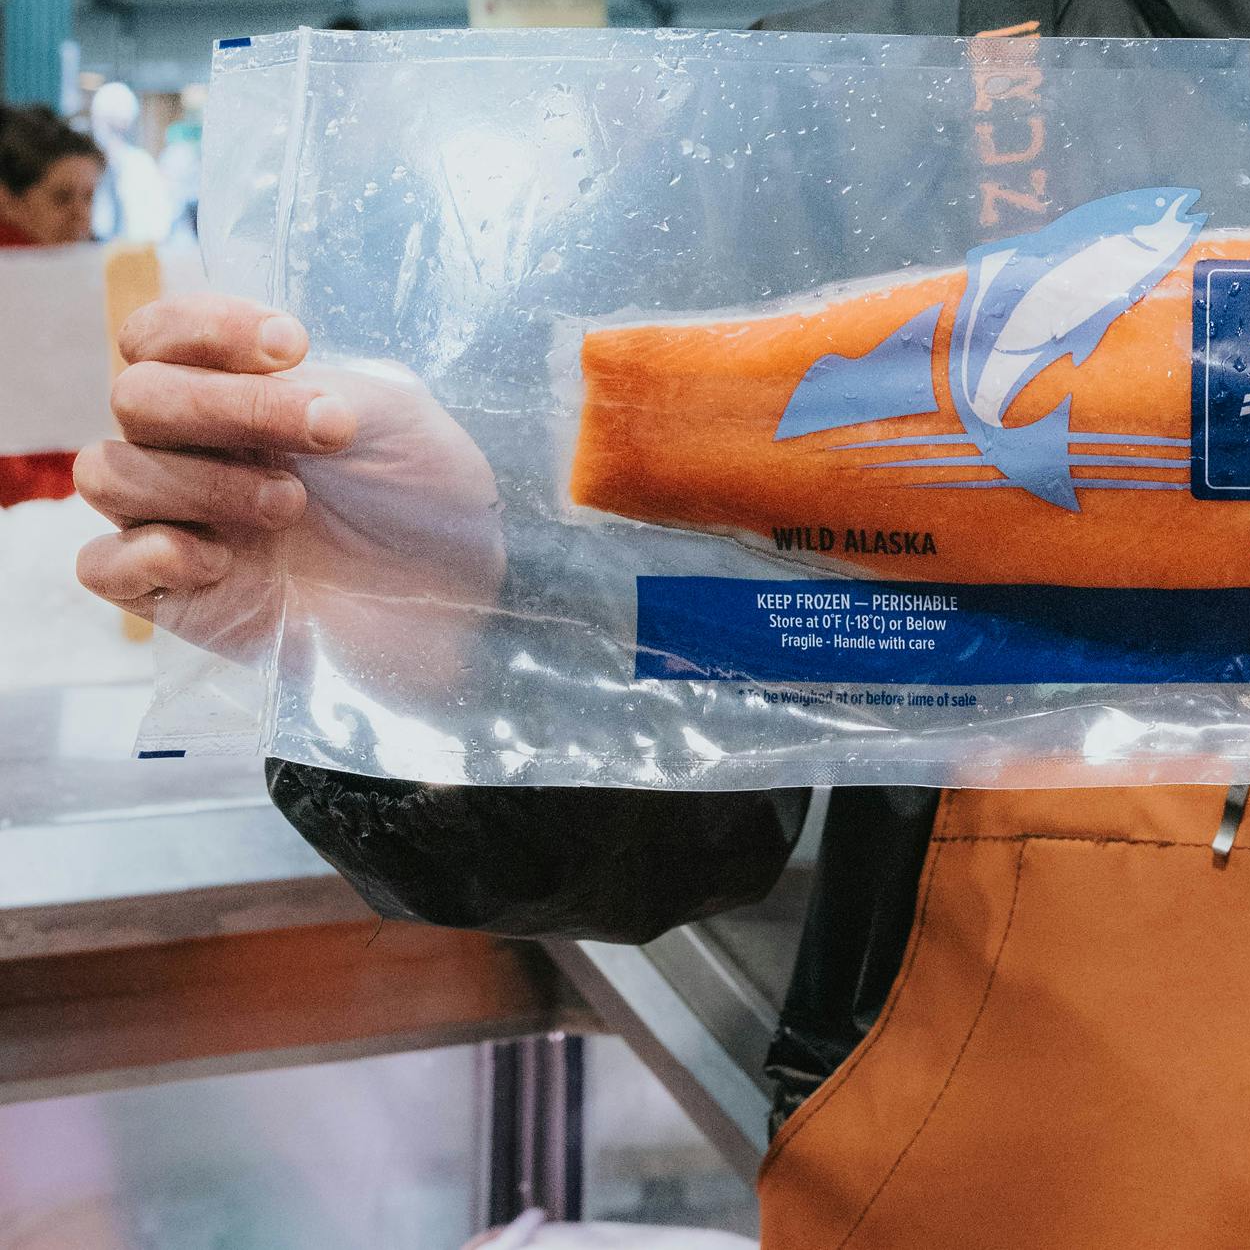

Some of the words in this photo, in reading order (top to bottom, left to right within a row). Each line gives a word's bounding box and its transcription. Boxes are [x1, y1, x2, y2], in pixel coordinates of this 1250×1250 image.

[771, 527, 834, 552] WILD
[844, 530, 938, 555] ALASKA
[757, 593, 792, 610] KEEP
[796, 593, 850, 610] FROZEN
[872, 594, 958, 611] PERISHABLE
[769, 614, 802, 629] Store
[806, 616, 819, 629] at
[889, 618, 903, 631] or
[906, 616, 946, 632] Below
[781, 633, 823, 651] Fragile
[834, 634, 876, 650] Handle
[878, 635, 905, 650] with
[908, 638, 935, 651] care
[763, 690, 778, 703] be
[836, 691, 848, 704] at
[850, 693, 863, 704] or
[866, 691, 904, 706] before
[936, 692, 950, 707] of
[951, 692, 977, 707] sale
